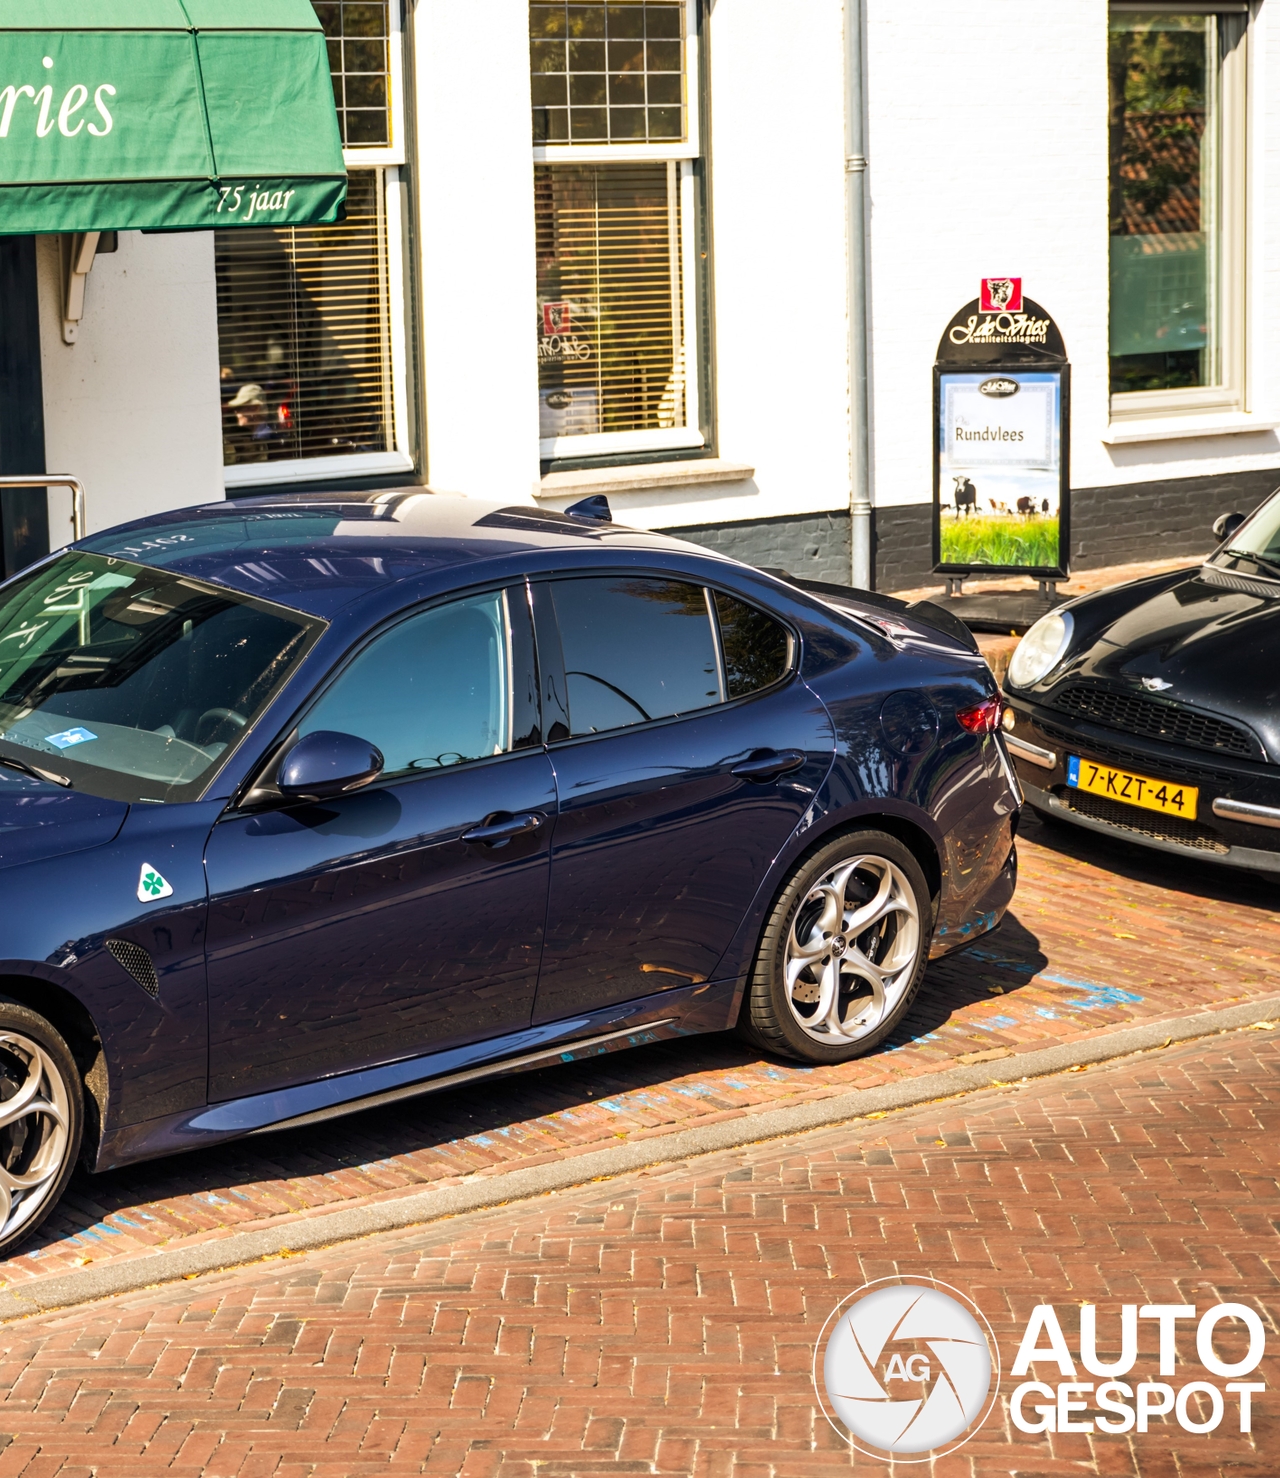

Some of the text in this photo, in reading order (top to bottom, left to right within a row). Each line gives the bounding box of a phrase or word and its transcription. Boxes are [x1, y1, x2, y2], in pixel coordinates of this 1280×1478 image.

[216, 183, 296, 221] 75 jaar
[995, 312, 1051, 337] Vries
[968, 334, 1047, 344] Kwaliteitsslagerij
[955, 426, 1024, 442] Rundvlees
[1069, 772, 1078, 783] NL
[1088, 765, 1185, 811] 7-KZT-44
